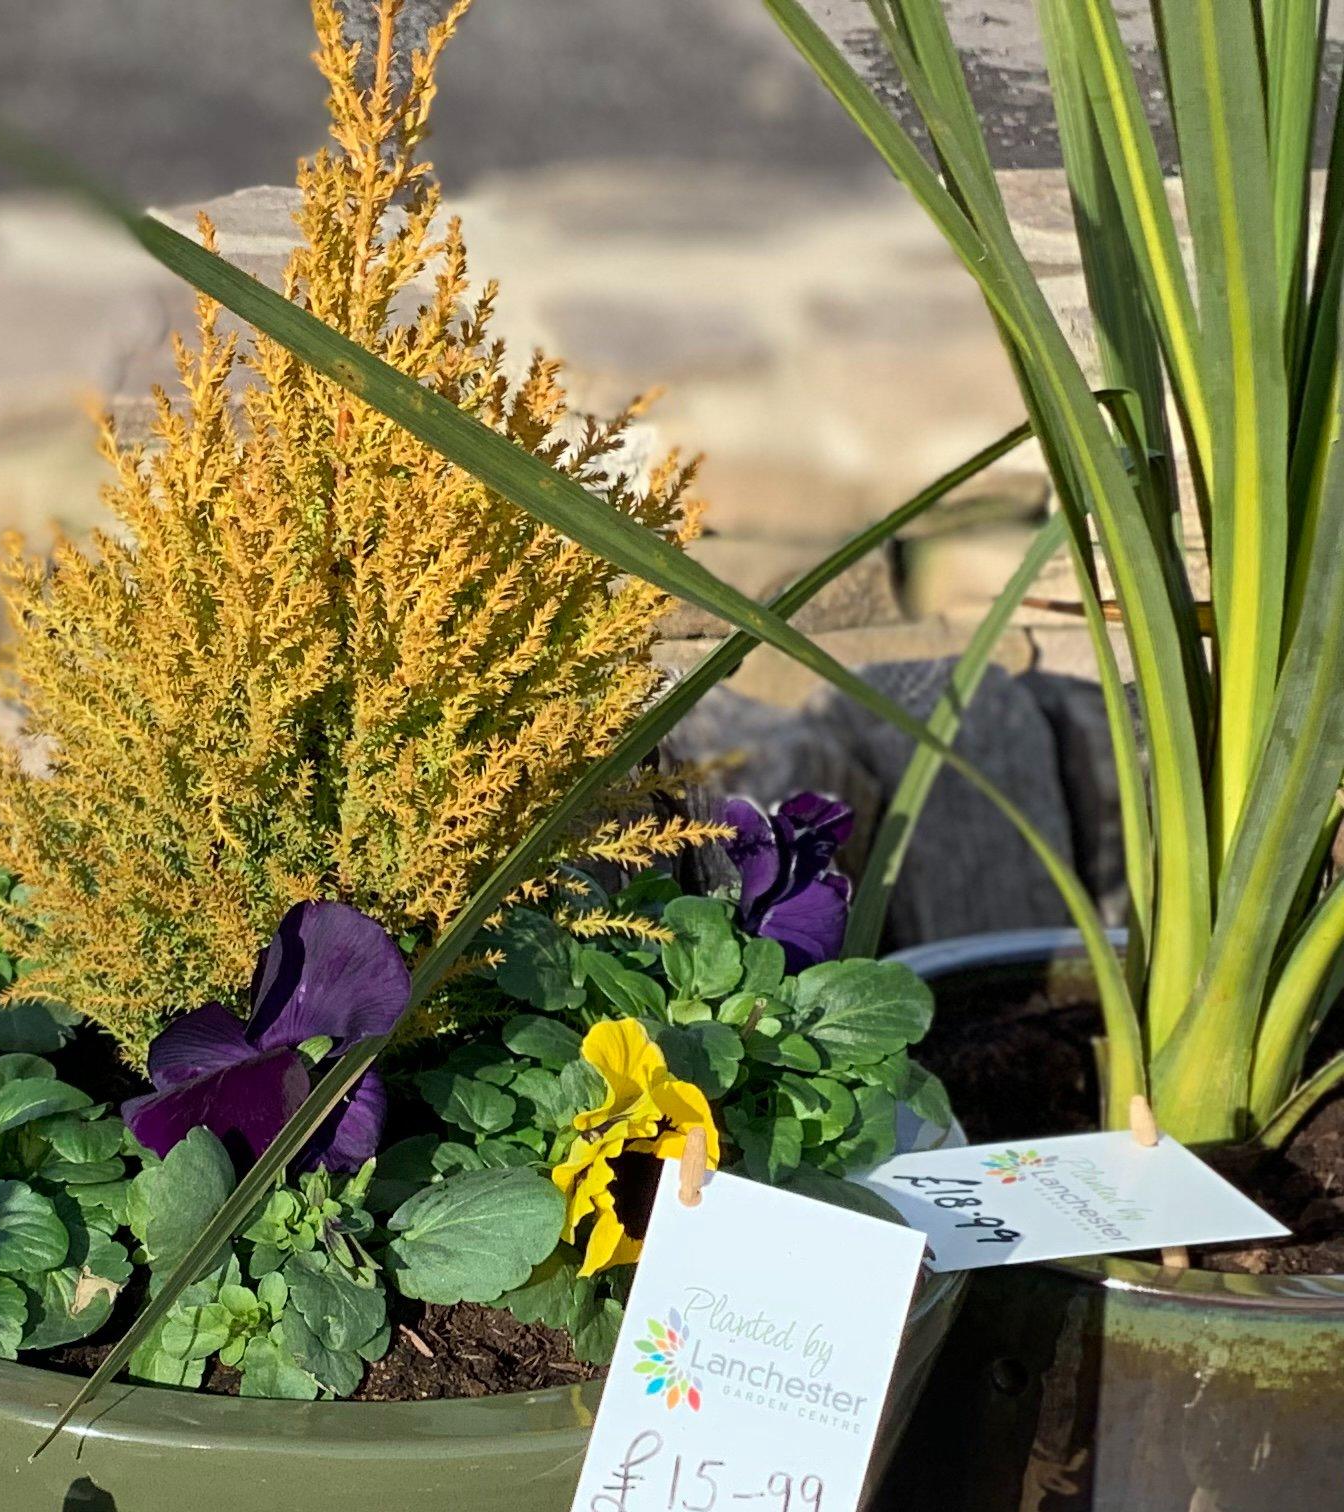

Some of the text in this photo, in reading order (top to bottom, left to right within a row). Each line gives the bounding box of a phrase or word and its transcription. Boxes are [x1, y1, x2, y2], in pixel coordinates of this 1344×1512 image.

[892, 1175, 1021, 1243] £18.99
[1031, 1170, 1131, 1242] Lanchester
[684, 1287, 833, 1378] Planted by
[691, 1339, 868, 1416] Lanchester
[723, 1385, 861, 1435] GARDEN CENTRE
